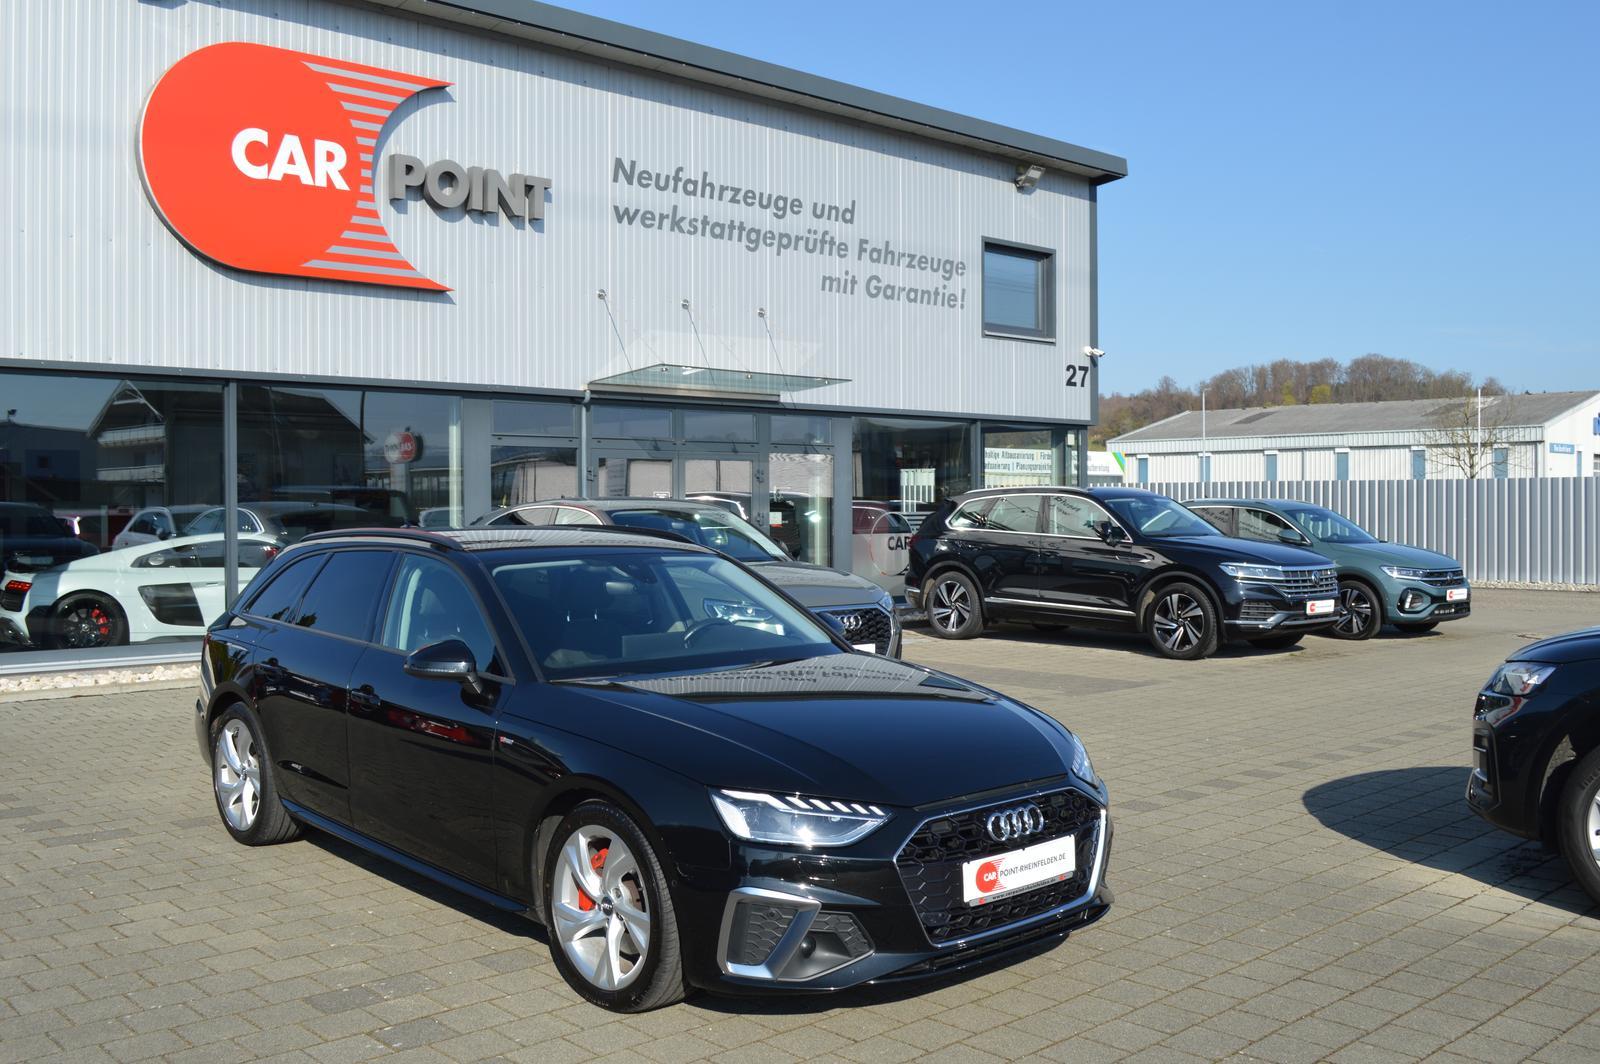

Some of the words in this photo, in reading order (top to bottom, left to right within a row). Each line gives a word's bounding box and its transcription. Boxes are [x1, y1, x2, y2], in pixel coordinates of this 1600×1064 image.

[231, 127, 350, 191] CAR
[389, 153, 552, 221] POINT
[612, 157, 803, 220] Neufahrzeuge
[812, 199, 856, 224] und
[613, 205, 849, 257] werkstattgeprüfte
[857, 237, 967, 281] Fahrzeuge
[820, 271, 857, 296] mit
[866, 275, 967, 310] Garantie!
[1065, 365, 1089, 388] 27
[984, 871, 997, 881] CAR
[999, 853, 1067, 877] POINT-RHEINFELDEN.DE
